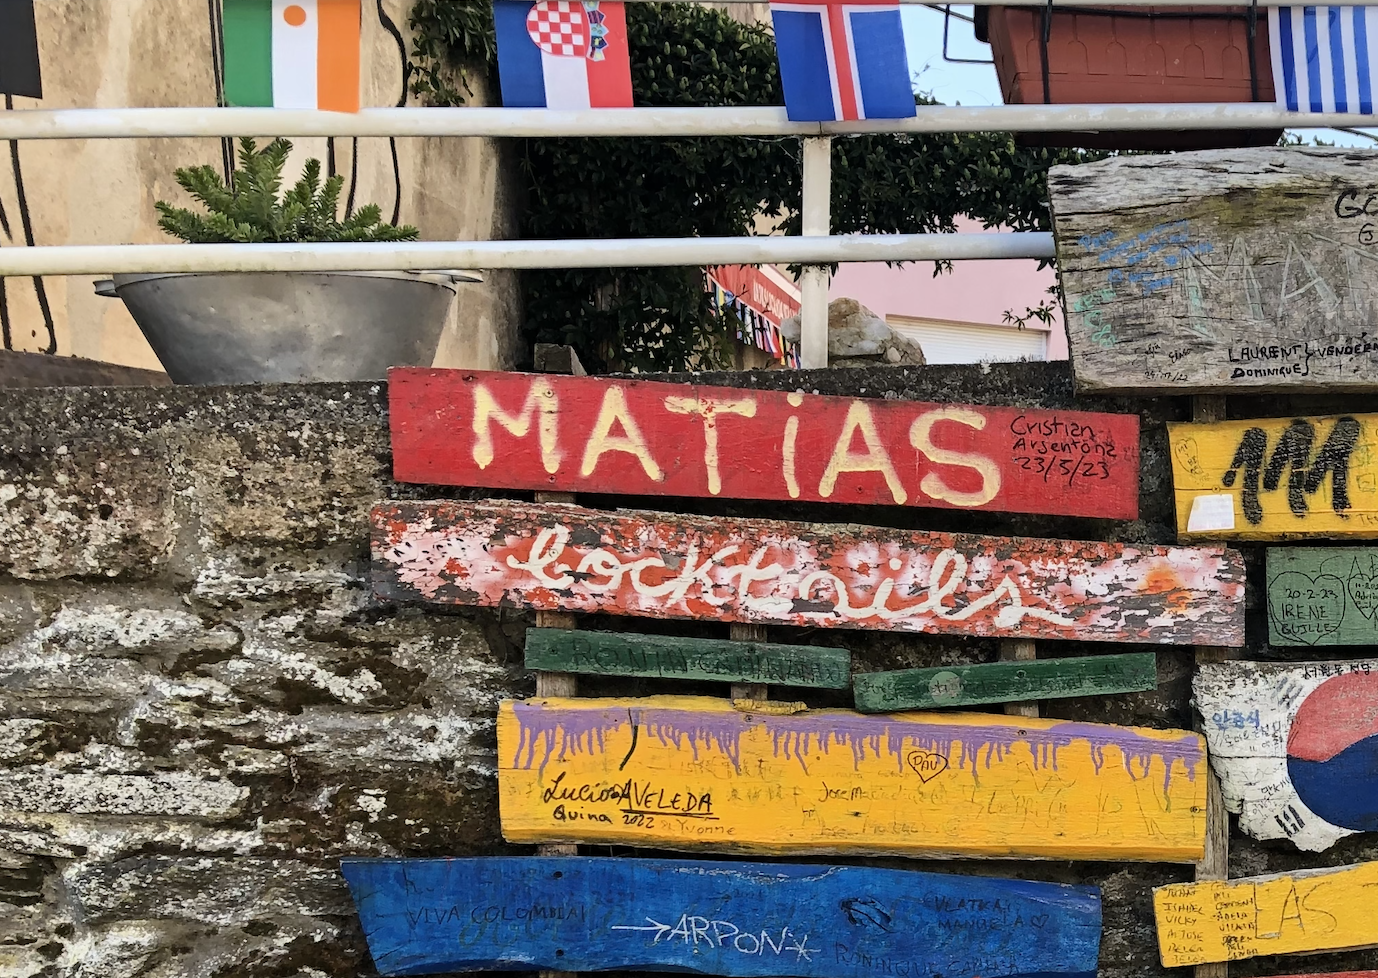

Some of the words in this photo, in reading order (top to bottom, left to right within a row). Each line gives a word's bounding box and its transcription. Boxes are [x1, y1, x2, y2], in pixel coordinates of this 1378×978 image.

[1281, 603, 1329, 620] IRENE
[622, 813, 655, 829] 2022
[406, 905, 461, 927] VIVA
